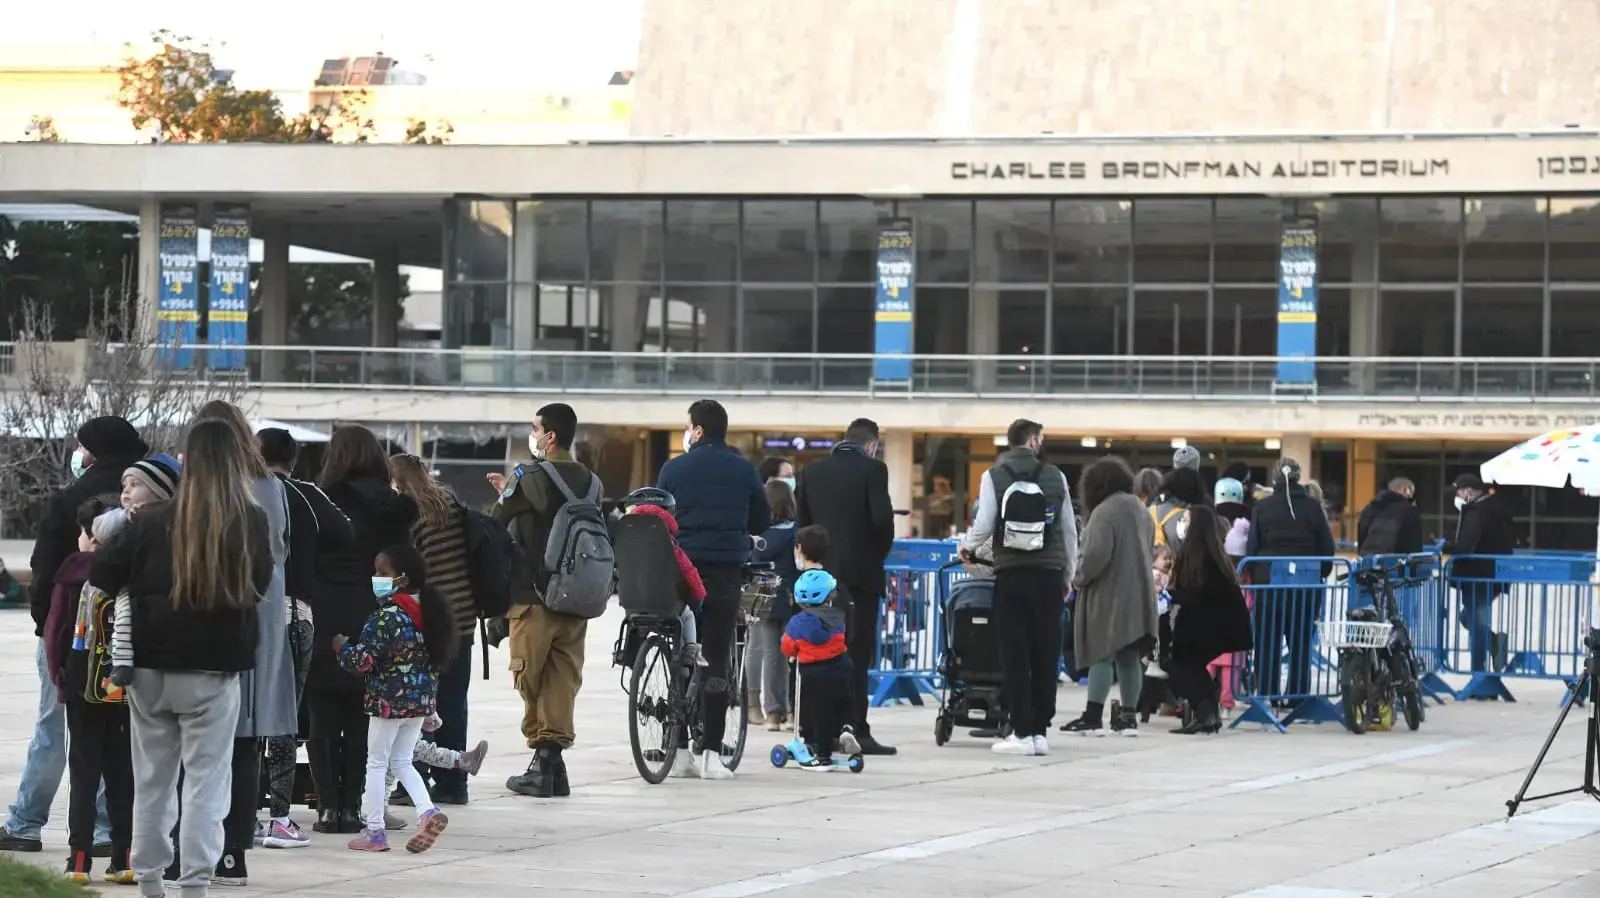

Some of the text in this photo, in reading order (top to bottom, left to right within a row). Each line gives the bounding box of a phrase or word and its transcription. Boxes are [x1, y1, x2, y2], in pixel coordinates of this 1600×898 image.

[951, 160, 1449, 179] CHARLES BRONFMAN AUDITORIUM
[169, 280, 183, 294] 4
[220, 280, 234, 294] 4
